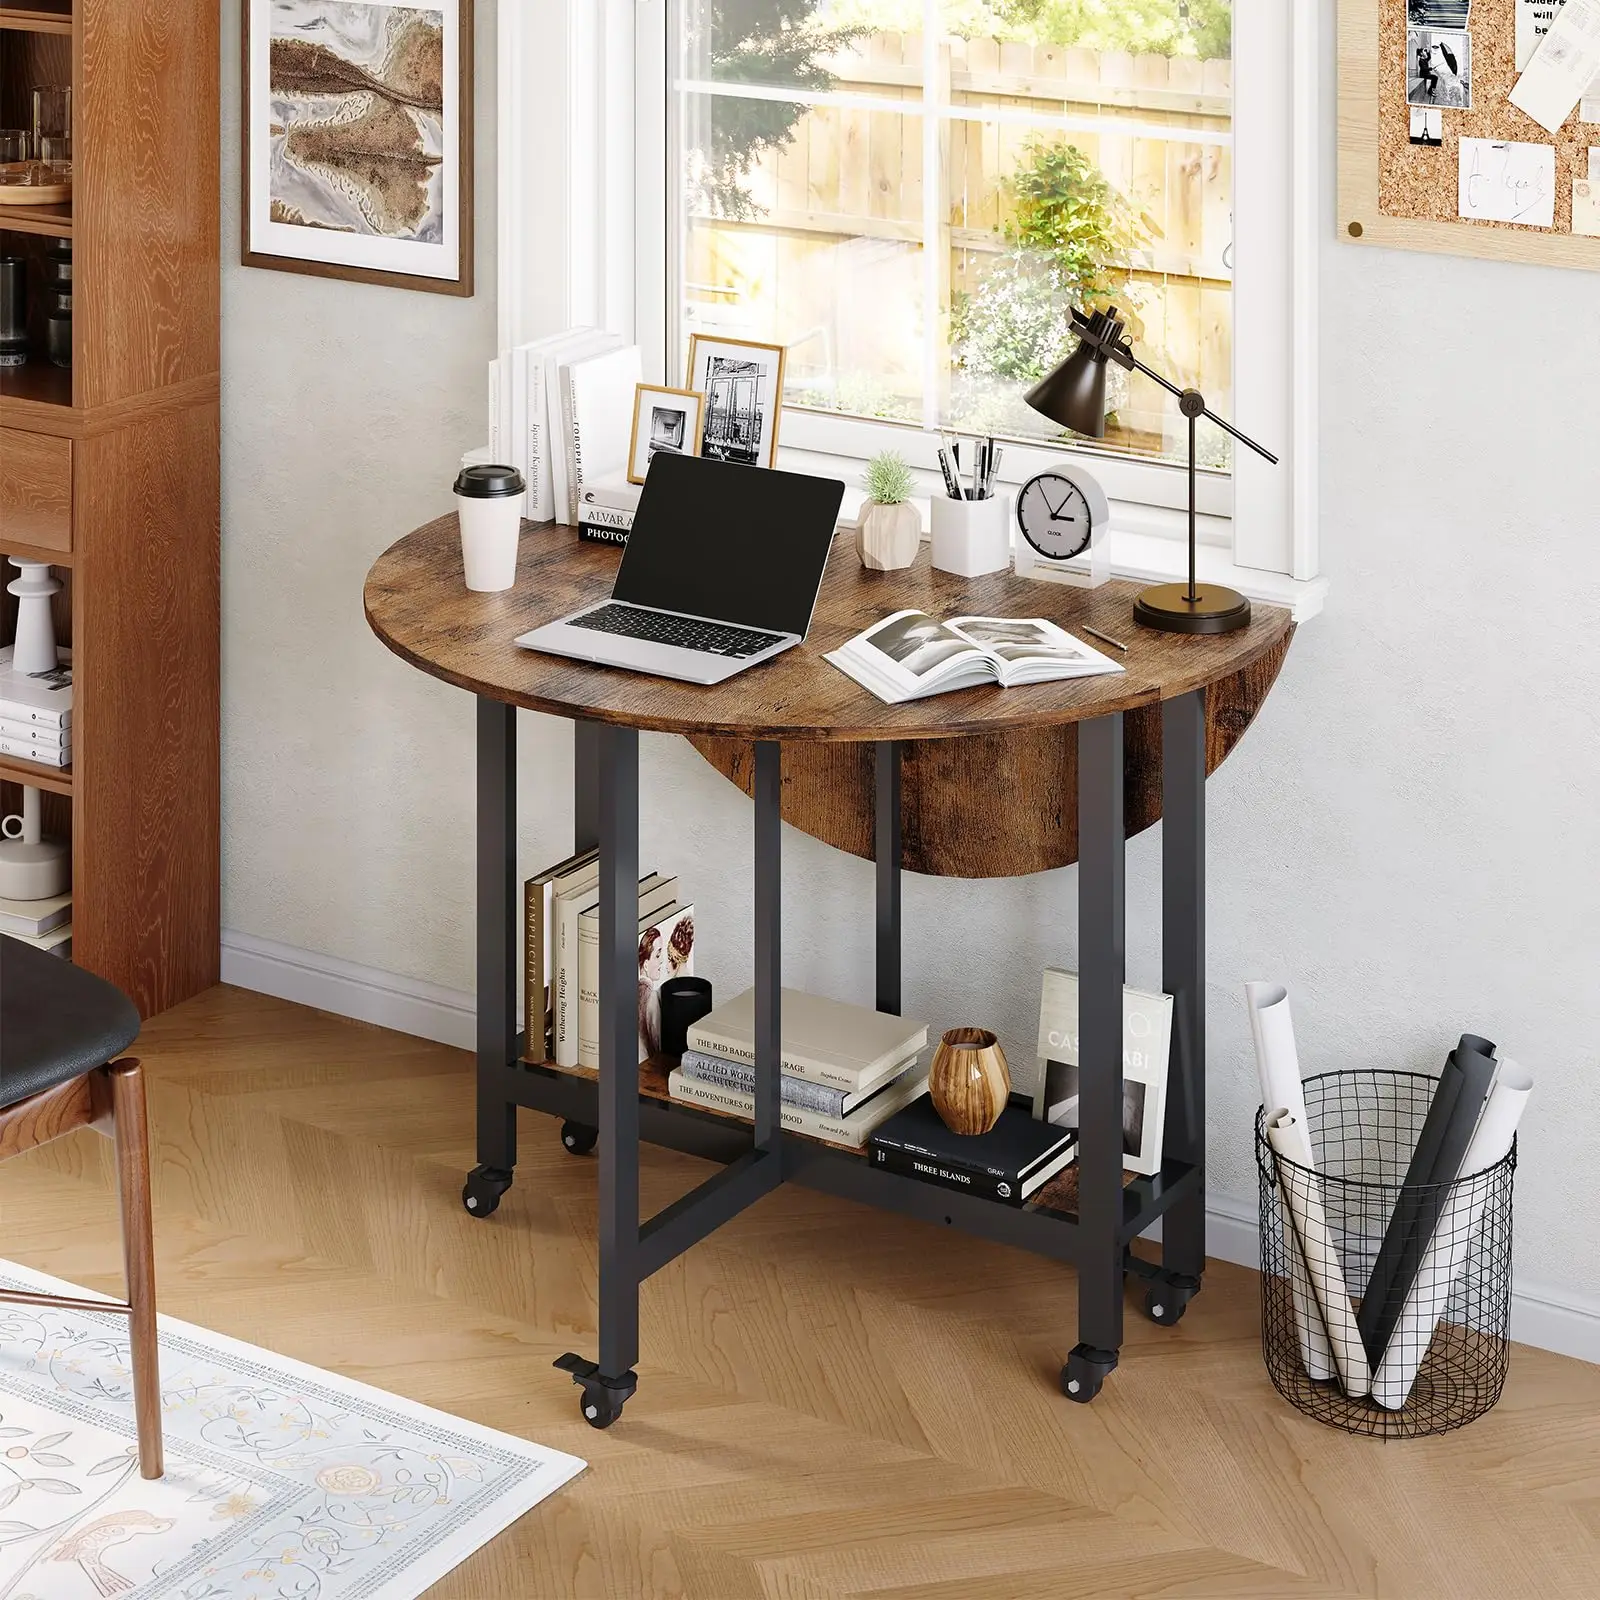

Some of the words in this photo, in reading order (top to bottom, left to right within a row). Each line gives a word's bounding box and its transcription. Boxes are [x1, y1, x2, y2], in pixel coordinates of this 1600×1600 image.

[1533, 11, 1553, 20] will
[1534, 25, 1549, 35] be
[573, 422, 582, 464] ГОВОРИ
[588, 511, 625, 526] ALVAR
[528, 897, 536, 985] SIMPLICITY
[559, 968, 567, 1000] Heights
[559, 1001, 567, 1042] Wuthering
[696, 1038, 712, 1049] THE
[712, 1043, 728, 1053] RED
[729, 1047, 755, 1060] BADGE
[696, 1061, 728, 1076] ALLIED
[679, 1085, 693, 1095] THE
[694, 1090, 743, 1109] ADVENTURES
[744, 1102, 755, 1112] OF
[818, 1123, 838, 1134] Howard
[838, 1129, 850, 1138] Pyle
[913, 1162, 938, 1176] THREE
[939, 1169, 971, 1184] ISLANDS
[987, 1167, 1005, 1177] GRAY
